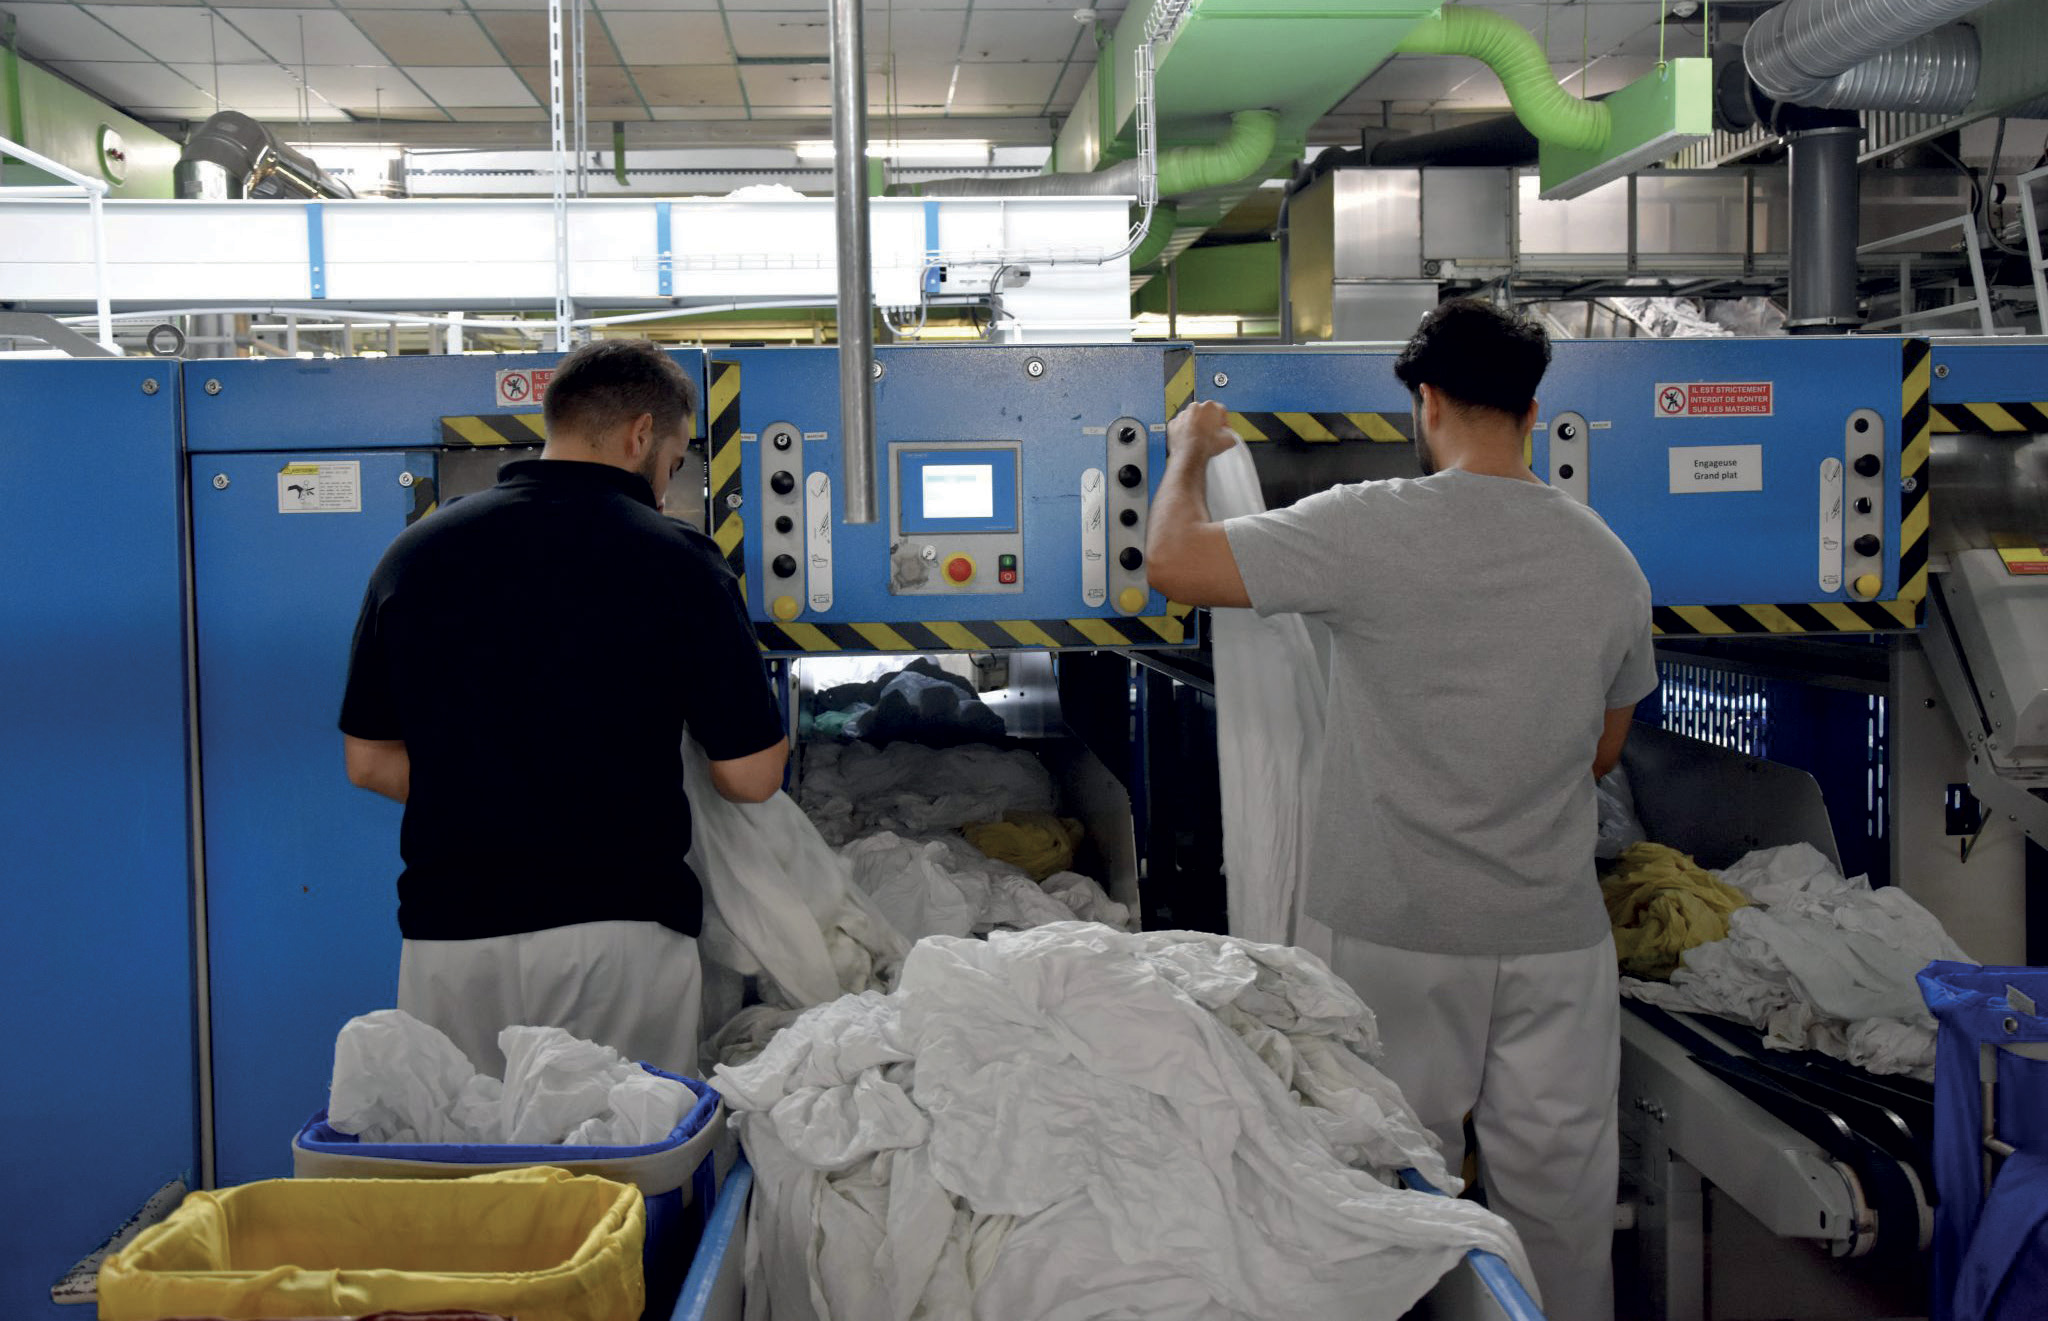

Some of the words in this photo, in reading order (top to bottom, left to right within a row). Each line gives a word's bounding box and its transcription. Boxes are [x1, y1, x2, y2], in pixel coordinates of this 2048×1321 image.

[1694, 459, 1737, 468] Engageuse
[1694, 472, 1719, 480] Grand
[1721, 471, 1738, 480] plat
